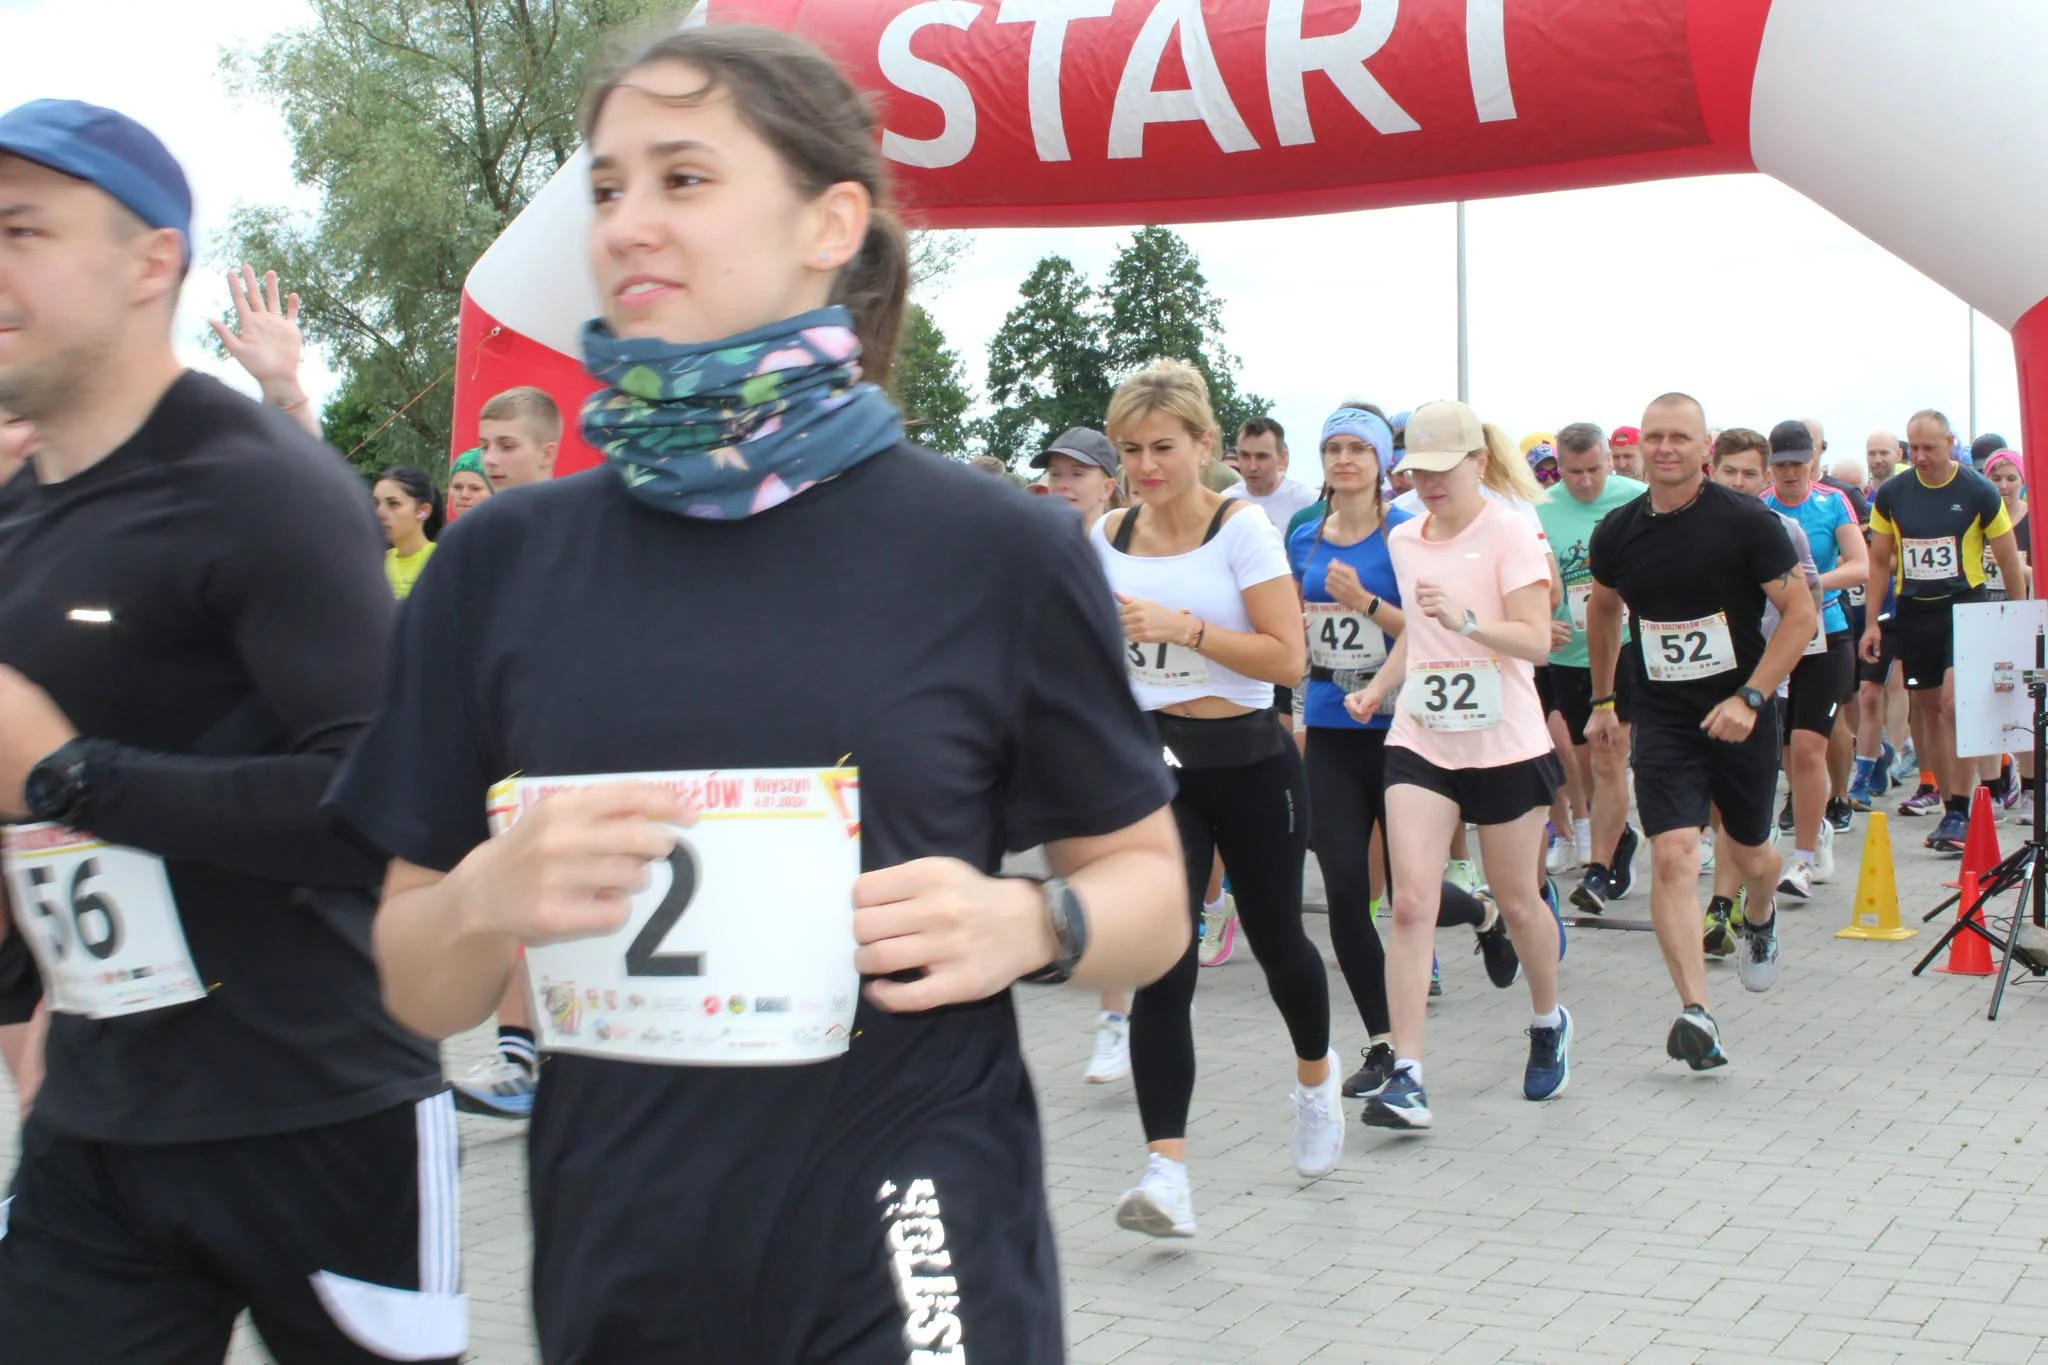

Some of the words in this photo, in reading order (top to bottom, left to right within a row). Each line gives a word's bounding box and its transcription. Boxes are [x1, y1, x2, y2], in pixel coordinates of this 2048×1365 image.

[877, 0, 1518, 169] START
[1908, 546, 1952, 568] 143
[1321, 617, 1363, 650] 42
[1661, 631, 1712, 664] 52
[1424, 673, 1478, 712] 32
[30, 856, 125, 961] 56
[625, 836, 707, 977] 2
